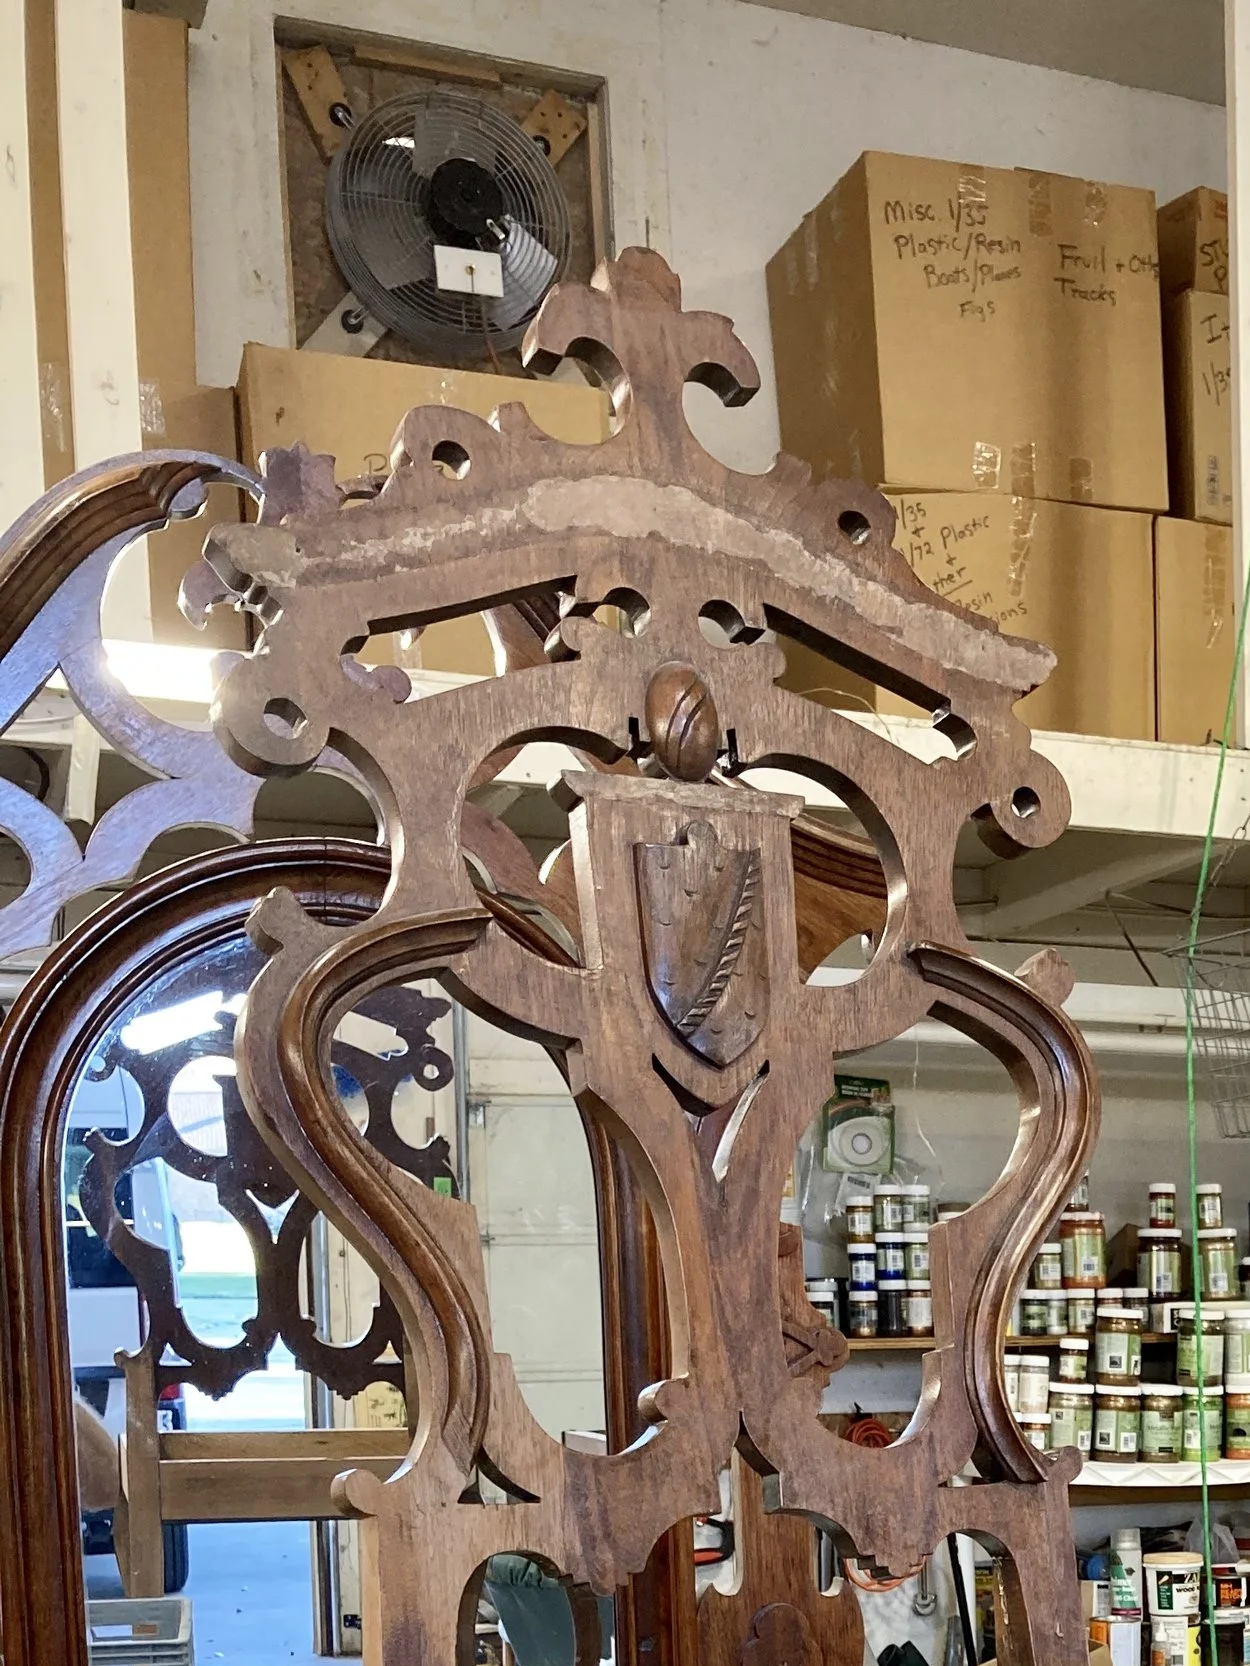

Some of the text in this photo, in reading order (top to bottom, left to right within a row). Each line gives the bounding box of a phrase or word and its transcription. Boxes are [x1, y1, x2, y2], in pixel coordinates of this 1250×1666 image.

[949, 196, 989, 233] 1/35
[959, 300, 996, 323] Figs
[940, 515, 990, 550] Plastic
[932, 565, 967, 593] ther
